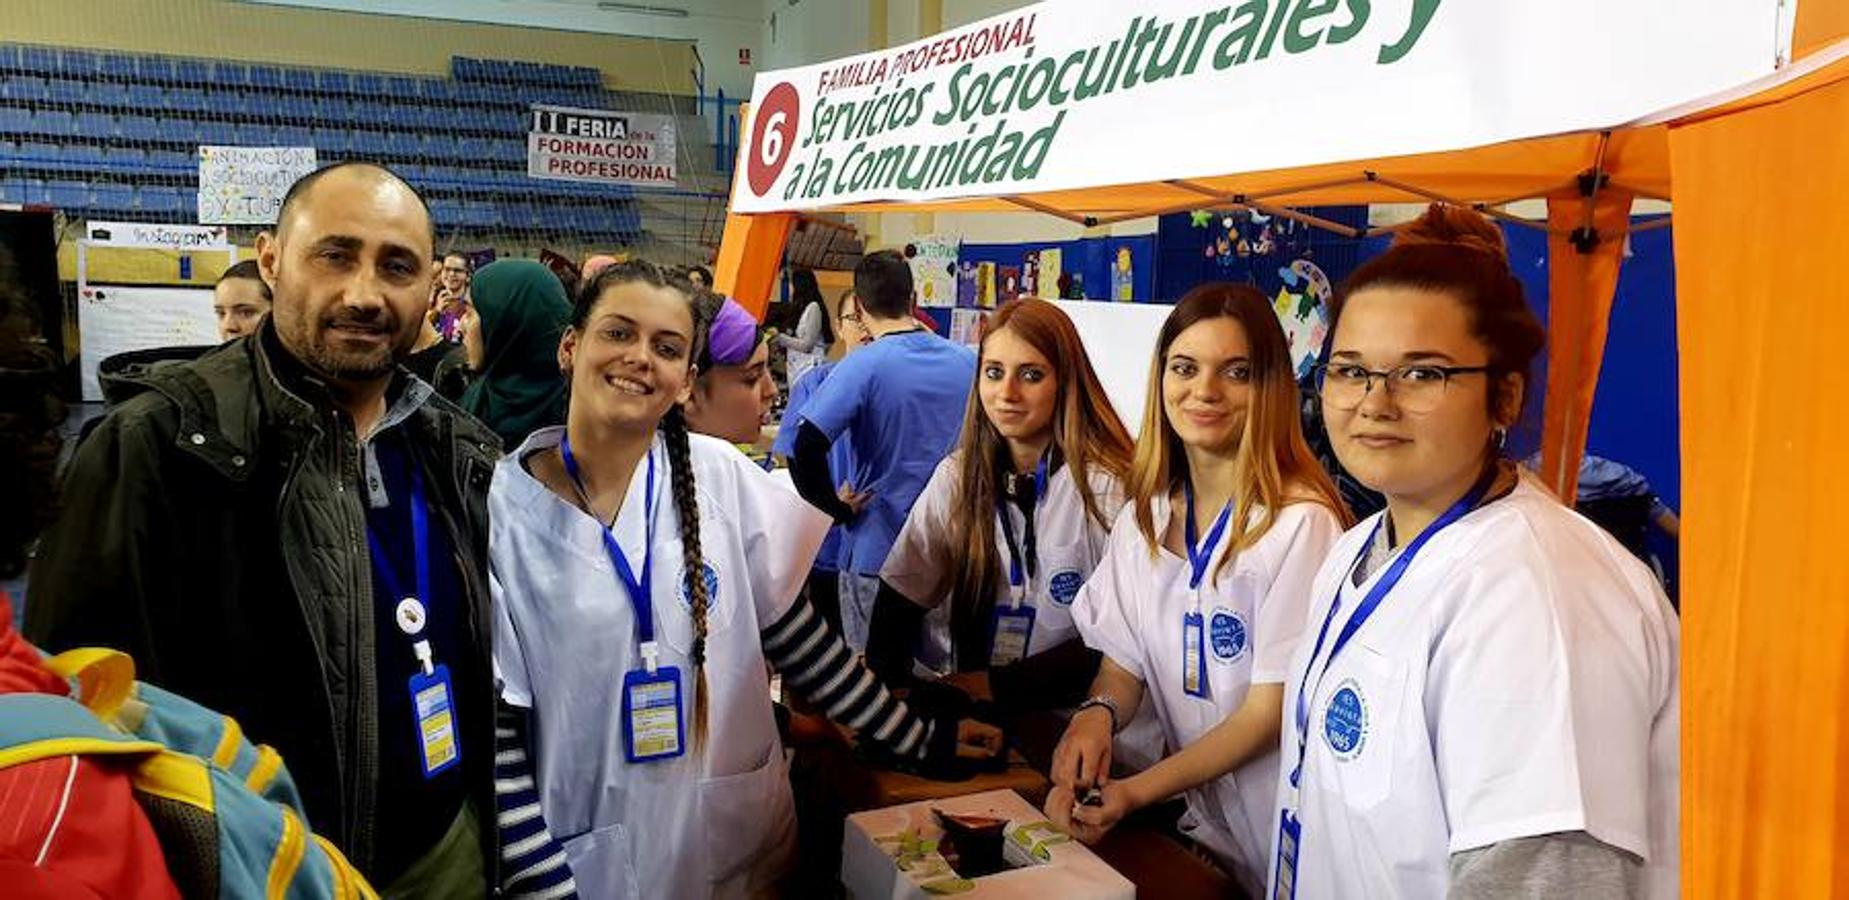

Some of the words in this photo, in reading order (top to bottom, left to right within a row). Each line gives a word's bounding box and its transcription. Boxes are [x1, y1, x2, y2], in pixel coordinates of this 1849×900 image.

[803, 78, 935, 148] Servicios
[933, 0, 1371, 126] Socioculturales
[1377, 0, 1443, 64] y
[817, 58, 888, 96] FAMILIA
[888, 13, 1037, 79] PROFESIONAL
[566, 117, 626, 139] FERIA
[761, 112, 787, 167] 6
[784, 162, 806, 200] a
[801, 148, 834, 199] la
[833, 110, 1069, 194] Comunidad
[548, 159, 677, 181] PROFESIONAL
